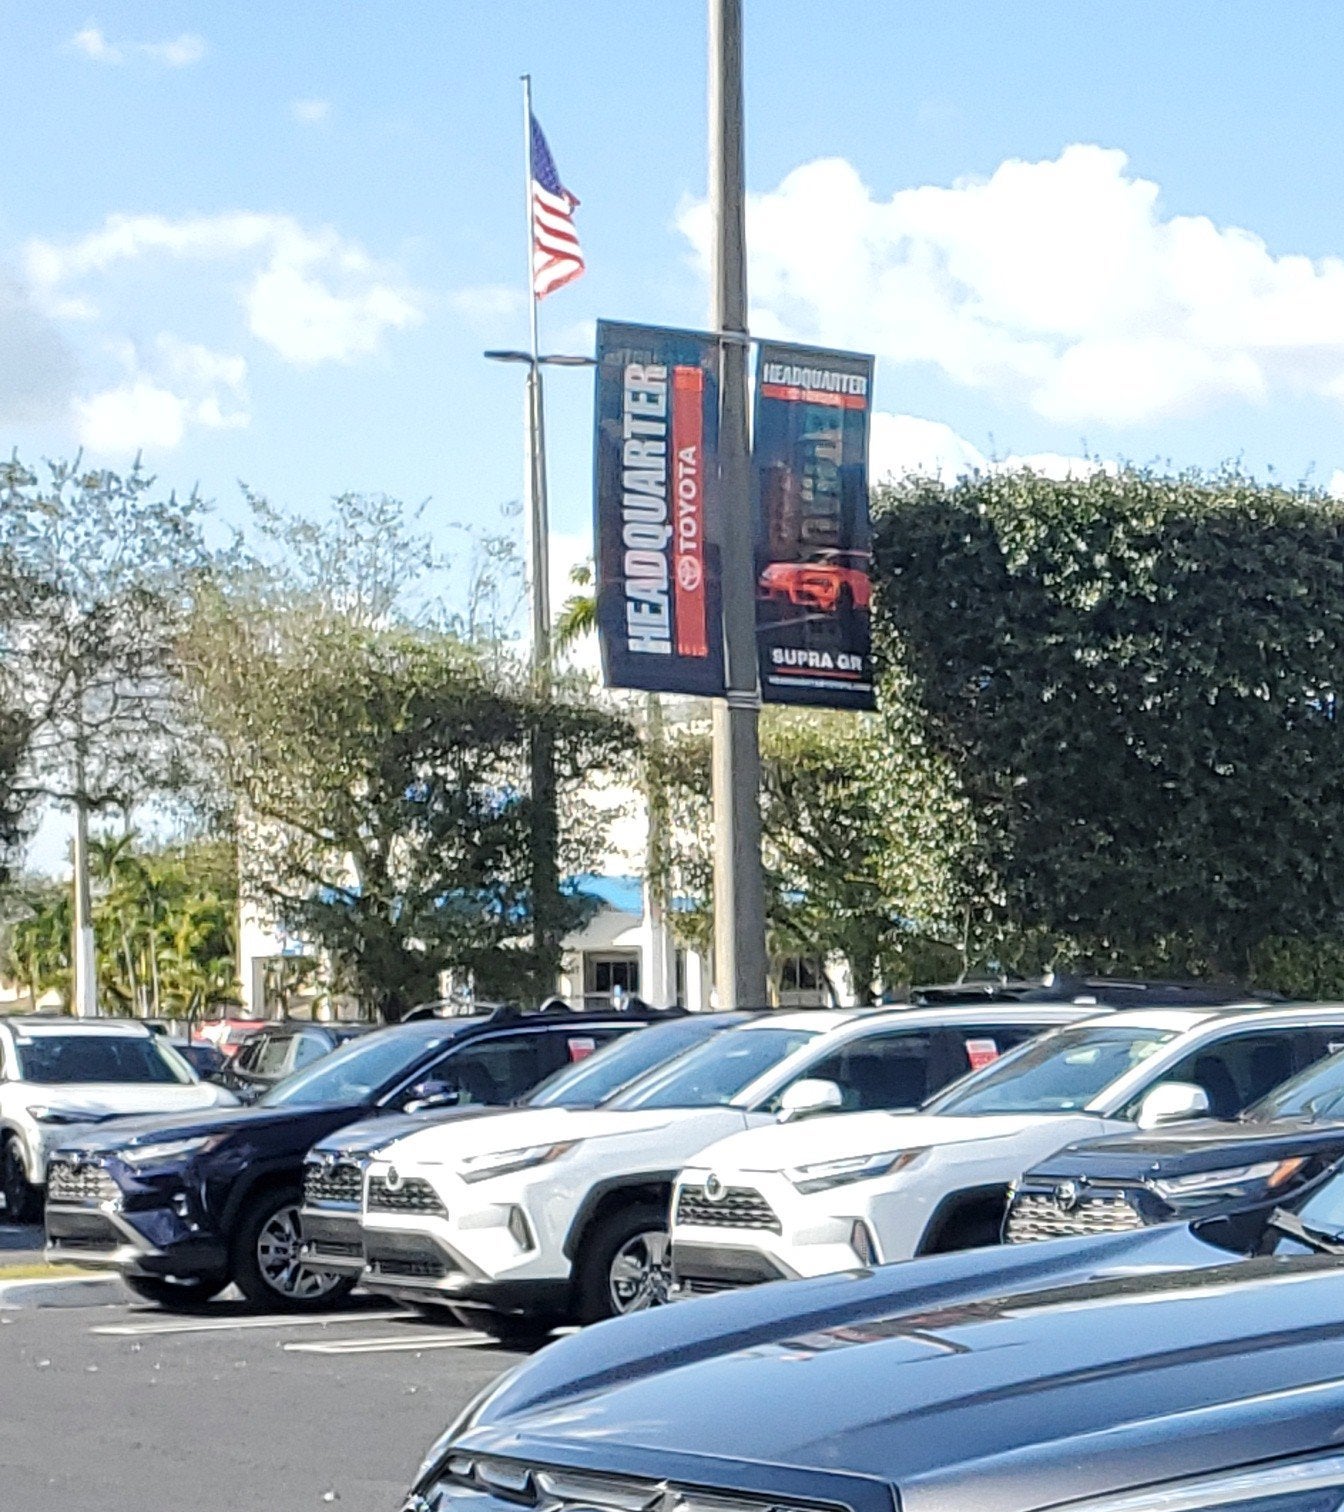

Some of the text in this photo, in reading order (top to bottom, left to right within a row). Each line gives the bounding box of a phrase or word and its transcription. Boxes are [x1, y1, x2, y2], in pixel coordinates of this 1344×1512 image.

[763, 362, 867, 395] HEADQUARTER
[623, 362, 673, 655] HEADQUARTER
[679, 445, 697, 554] TOYOTA
[772, 648, 863, 671] SUPRA GR
